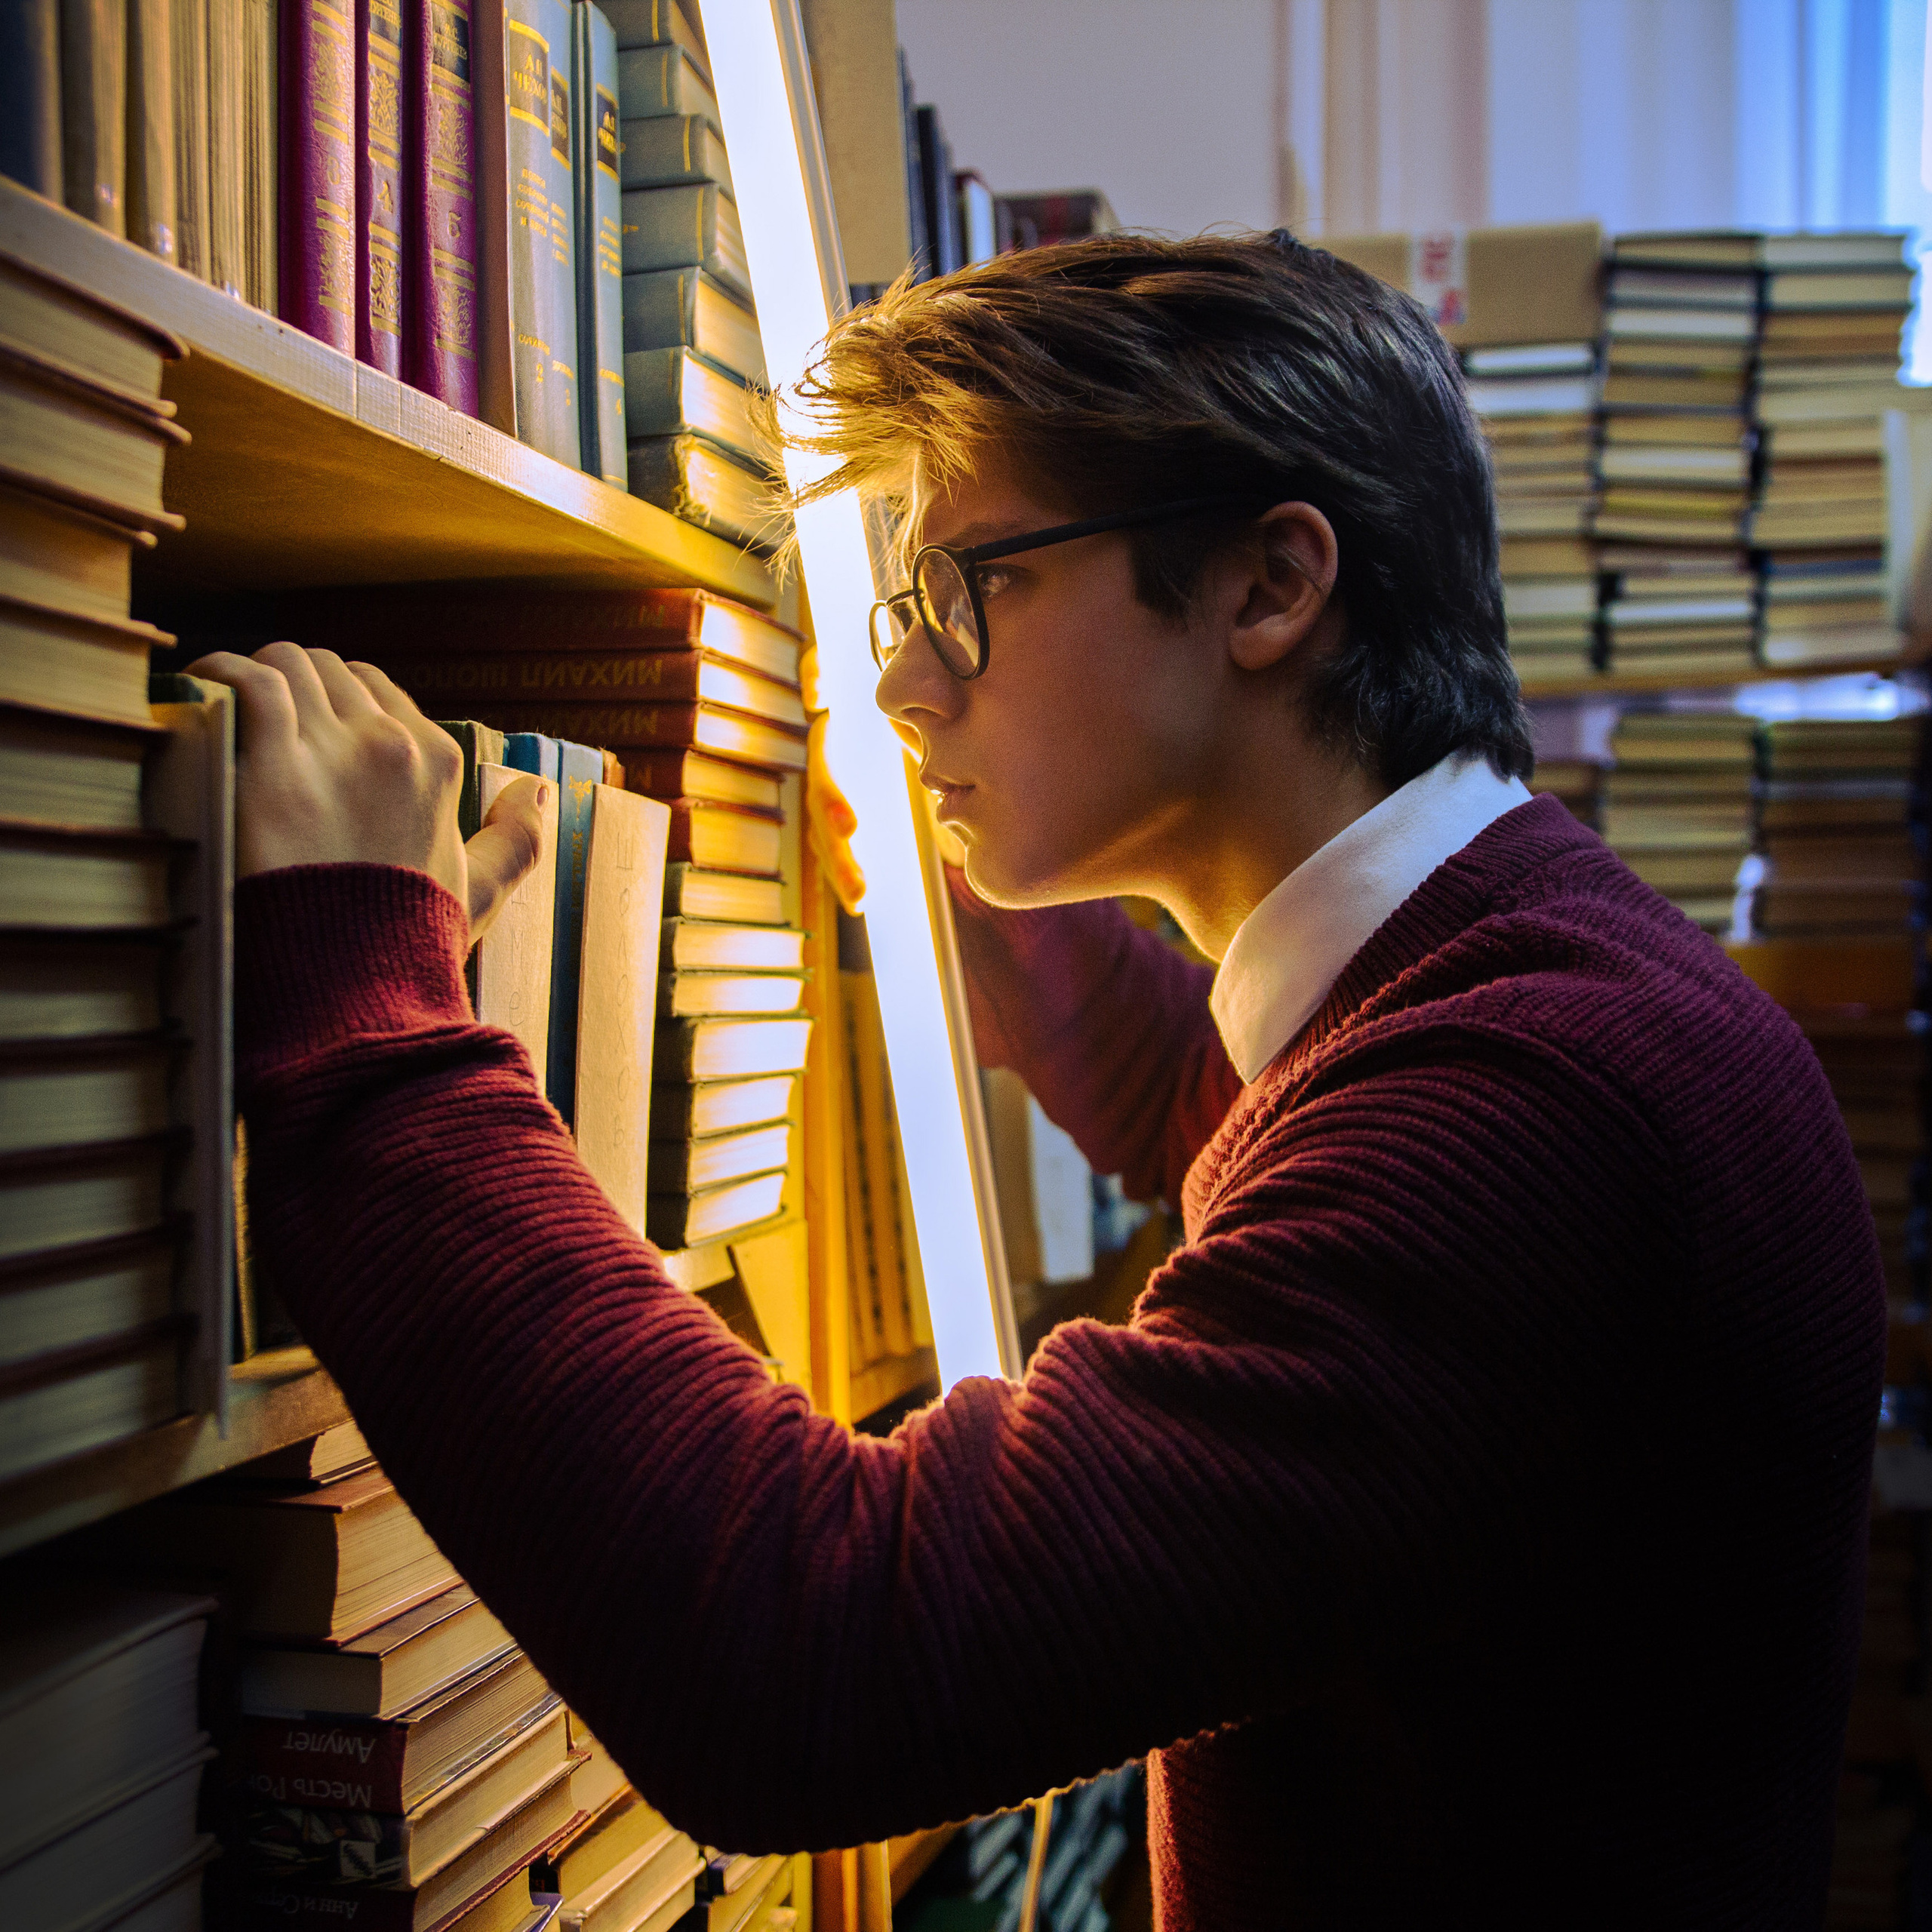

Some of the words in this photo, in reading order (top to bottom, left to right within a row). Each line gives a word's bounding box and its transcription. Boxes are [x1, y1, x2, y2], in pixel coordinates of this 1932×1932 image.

[377, 181, 392, 213] 4
[536, 363, 543, 383] 2
[519, 658, 663, 688] МИХАИЛ
[282, 1729, 376, 1764] Амулет
[292, 1778, 373, 1808] Месть
